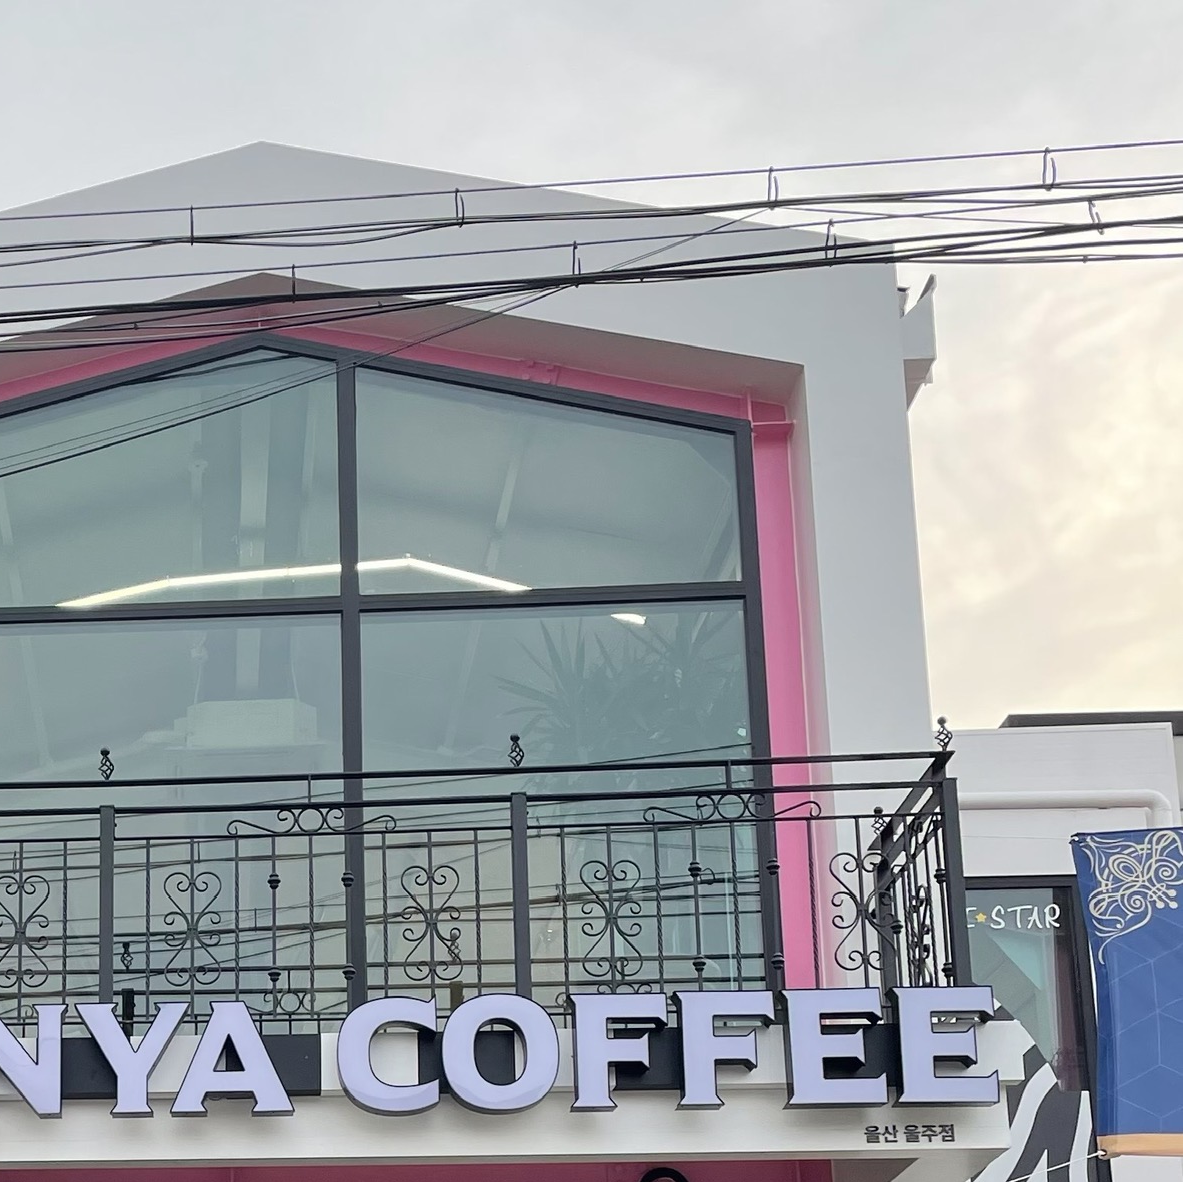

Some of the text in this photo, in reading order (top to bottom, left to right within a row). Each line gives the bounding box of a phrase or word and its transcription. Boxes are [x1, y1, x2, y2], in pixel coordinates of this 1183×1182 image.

[990, 903, 1061, 929] STAR
[336, 986, 1001, 1116] COFFEE
[864, 1123, 955, 1143] 울산 울주점
